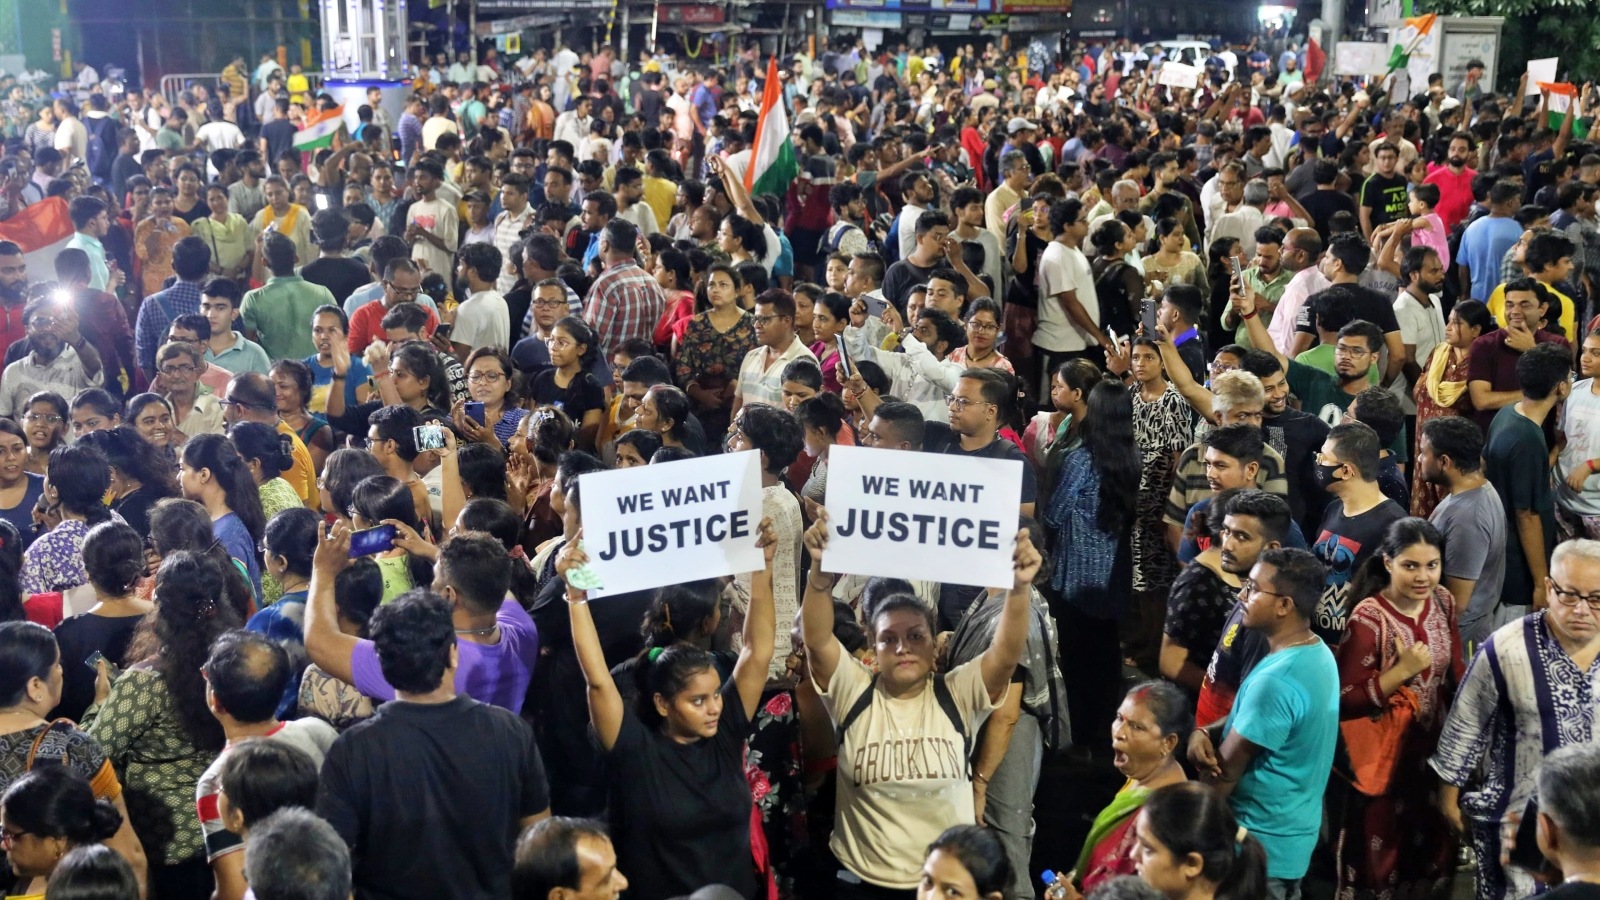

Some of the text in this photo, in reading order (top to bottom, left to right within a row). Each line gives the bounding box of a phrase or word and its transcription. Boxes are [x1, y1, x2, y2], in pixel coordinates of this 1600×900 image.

[616, 480, 731, 514] WE WANT
[861, 474, 984, 503] WE WANT
[599, 509, 749, 561] JUSTICE
[836, 508, 999, 550] JUSTICE
[853, 737, 961, 788] BROOKLYN
